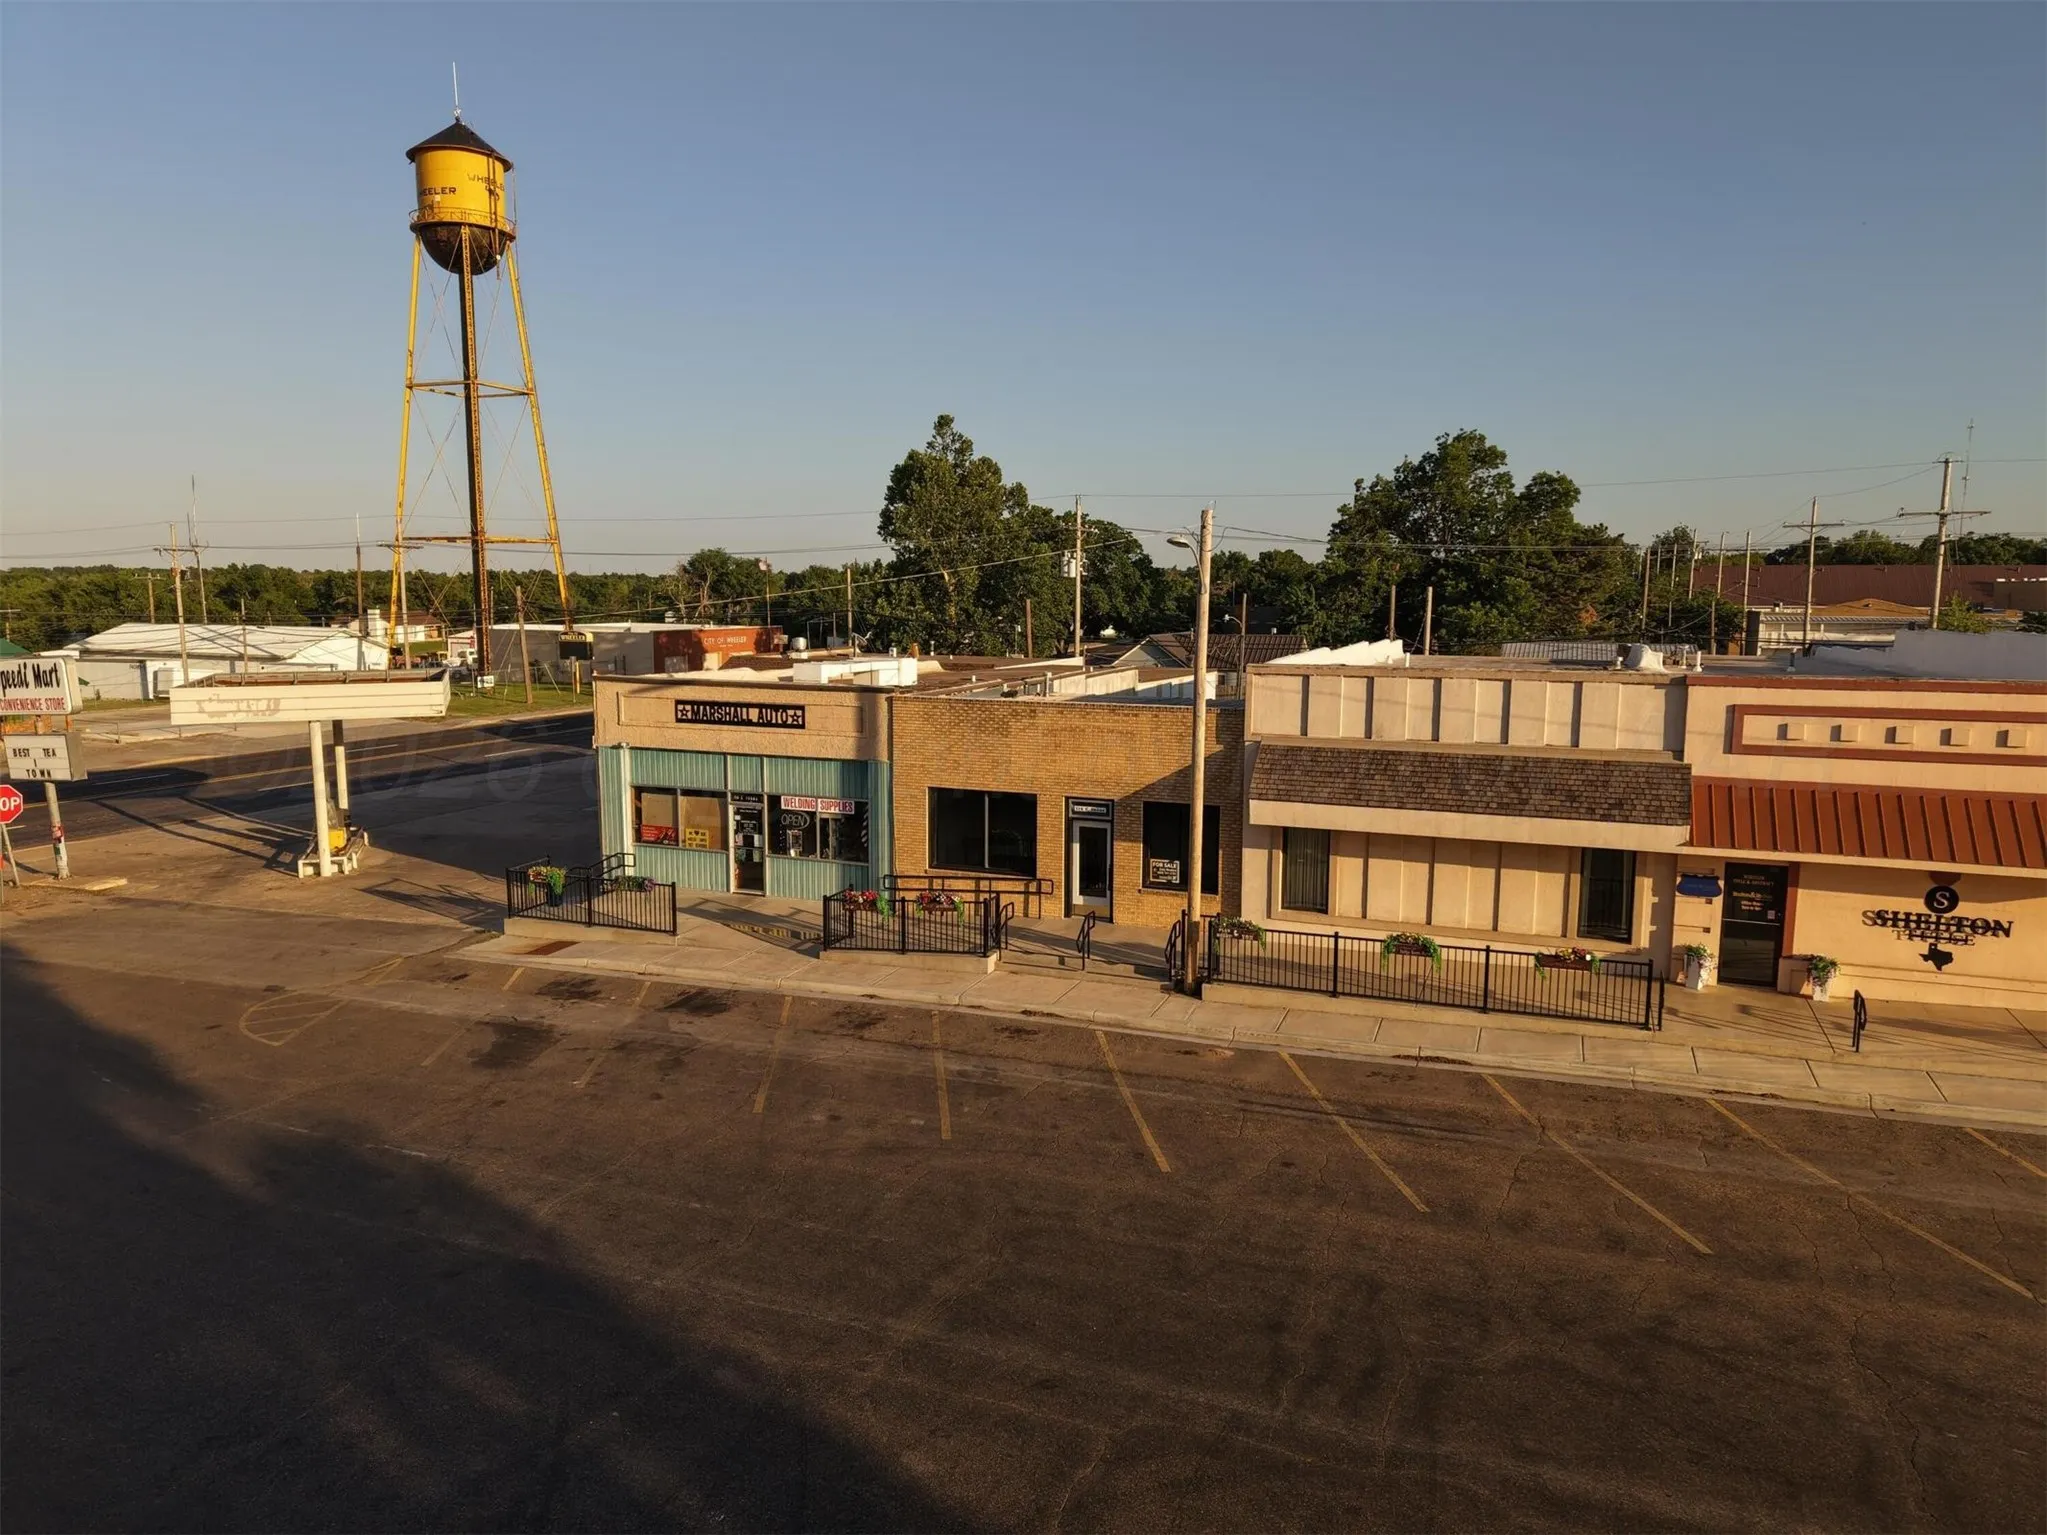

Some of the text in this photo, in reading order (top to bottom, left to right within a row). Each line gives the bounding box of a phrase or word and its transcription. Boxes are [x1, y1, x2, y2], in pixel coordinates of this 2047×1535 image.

[32, 662, 61, 689] Mart
[45, 697, 66, 711] STORE
[690, 704, 789, 724] MARSHALL AUTO
[13, 748, 57, 758] BEST TEA
[783, 797, 853, 813] WELDING SUPPLIES
[781, 813, 805, 826] OPEN
[1933, 891, 1951, 909] S
[1873, 909, 2015, 938] SHELTON
